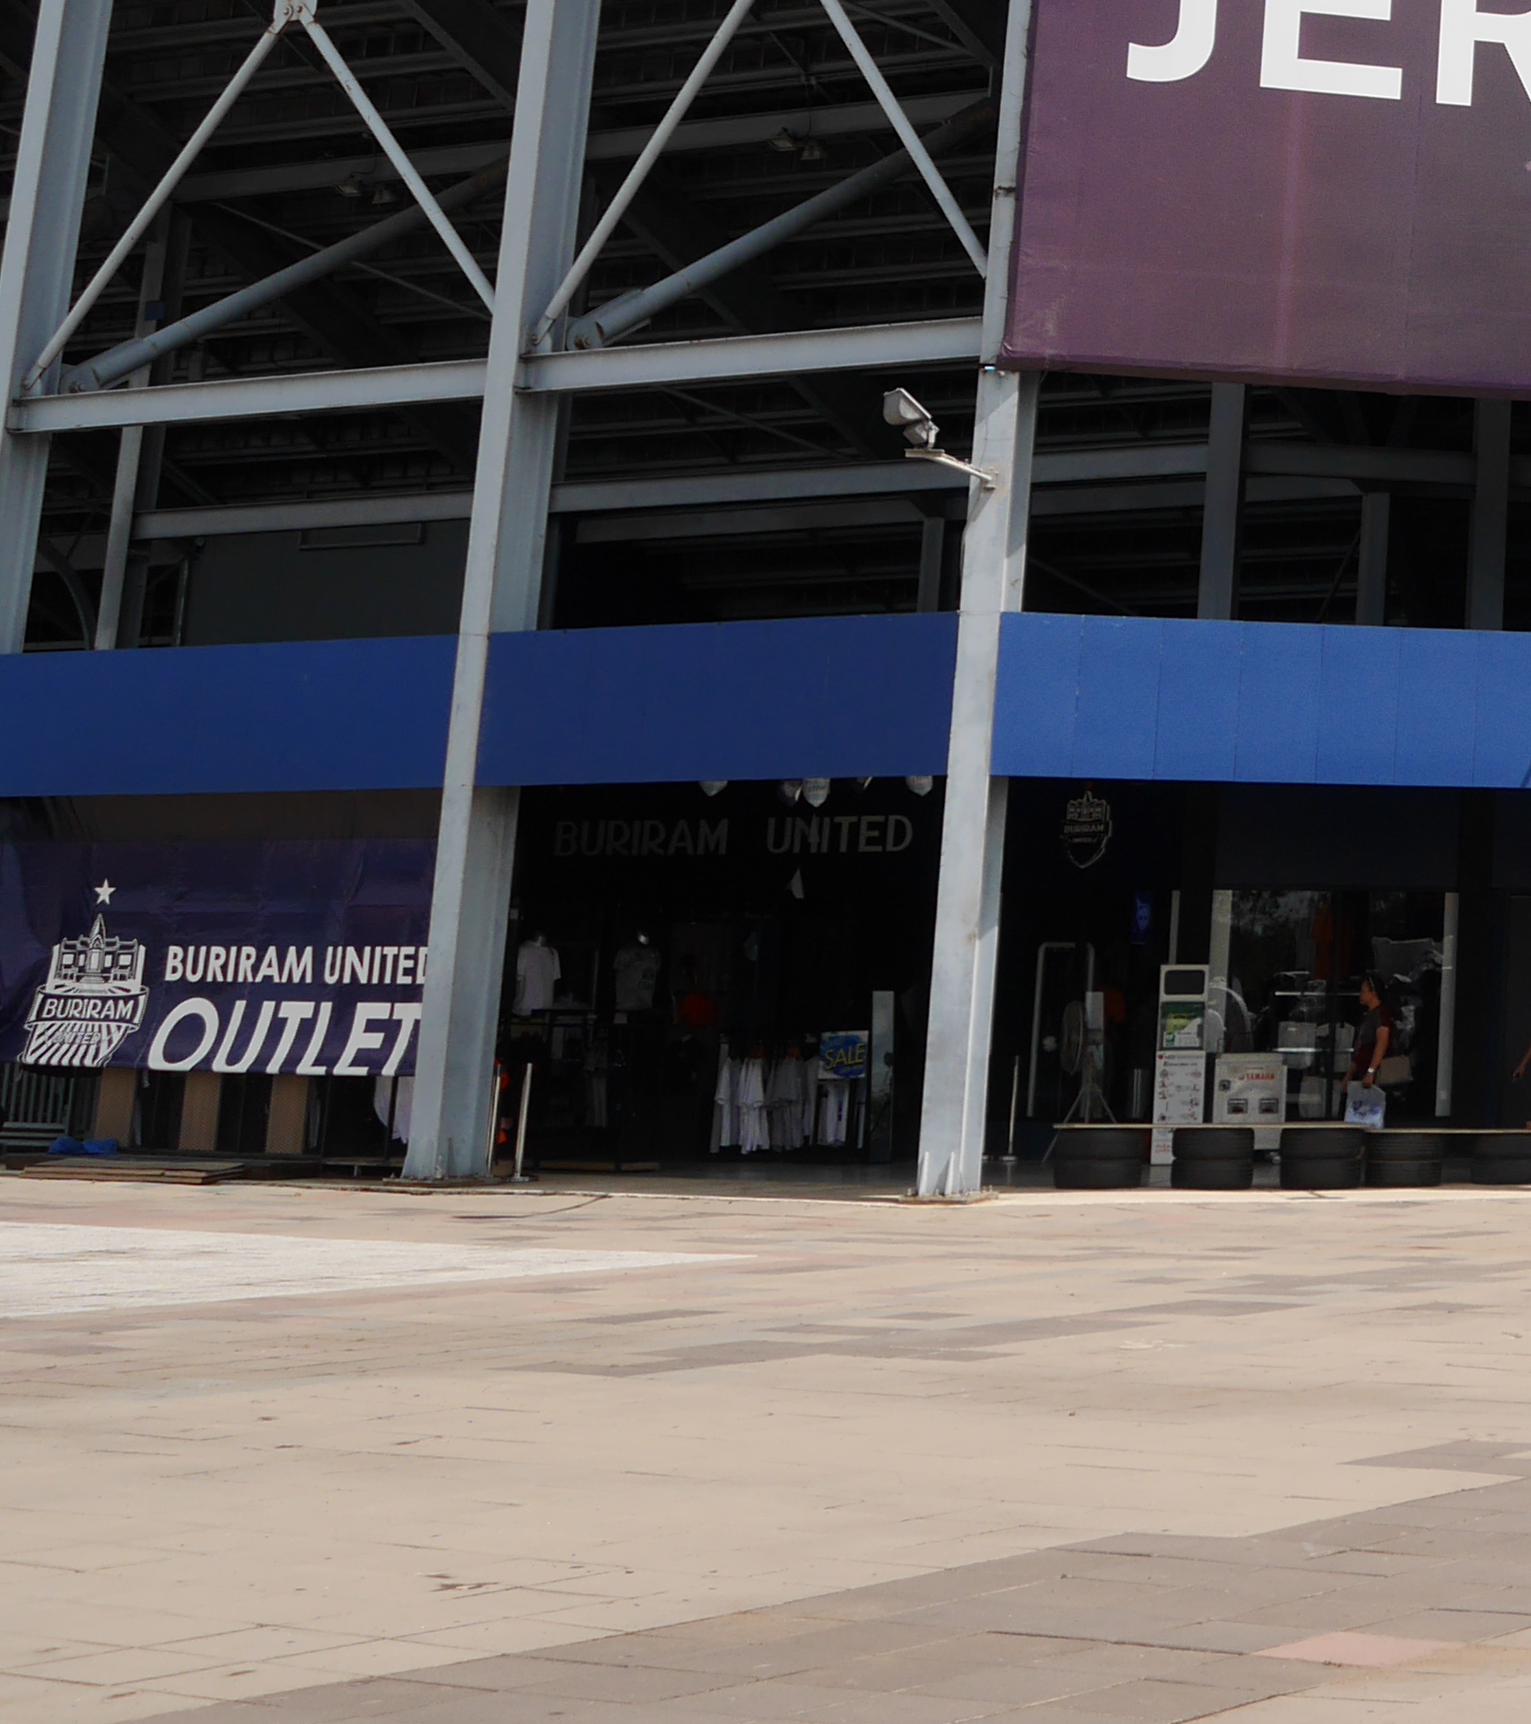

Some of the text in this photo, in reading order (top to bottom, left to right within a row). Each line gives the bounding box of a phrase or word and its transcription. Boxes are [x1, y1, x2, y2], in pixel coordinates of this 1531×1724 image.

[554, 814, 914, 856] BURIRAM UNITED
[165, 945, 313, 983] BURIRAM
[41, 998, 134, 1019] BURIRAM
[147, 997, 423, 1076] OUTLET
[824, 1043, 866, 1071] SALE
[1246, 1073, 1275, 1081] YAMAHA
